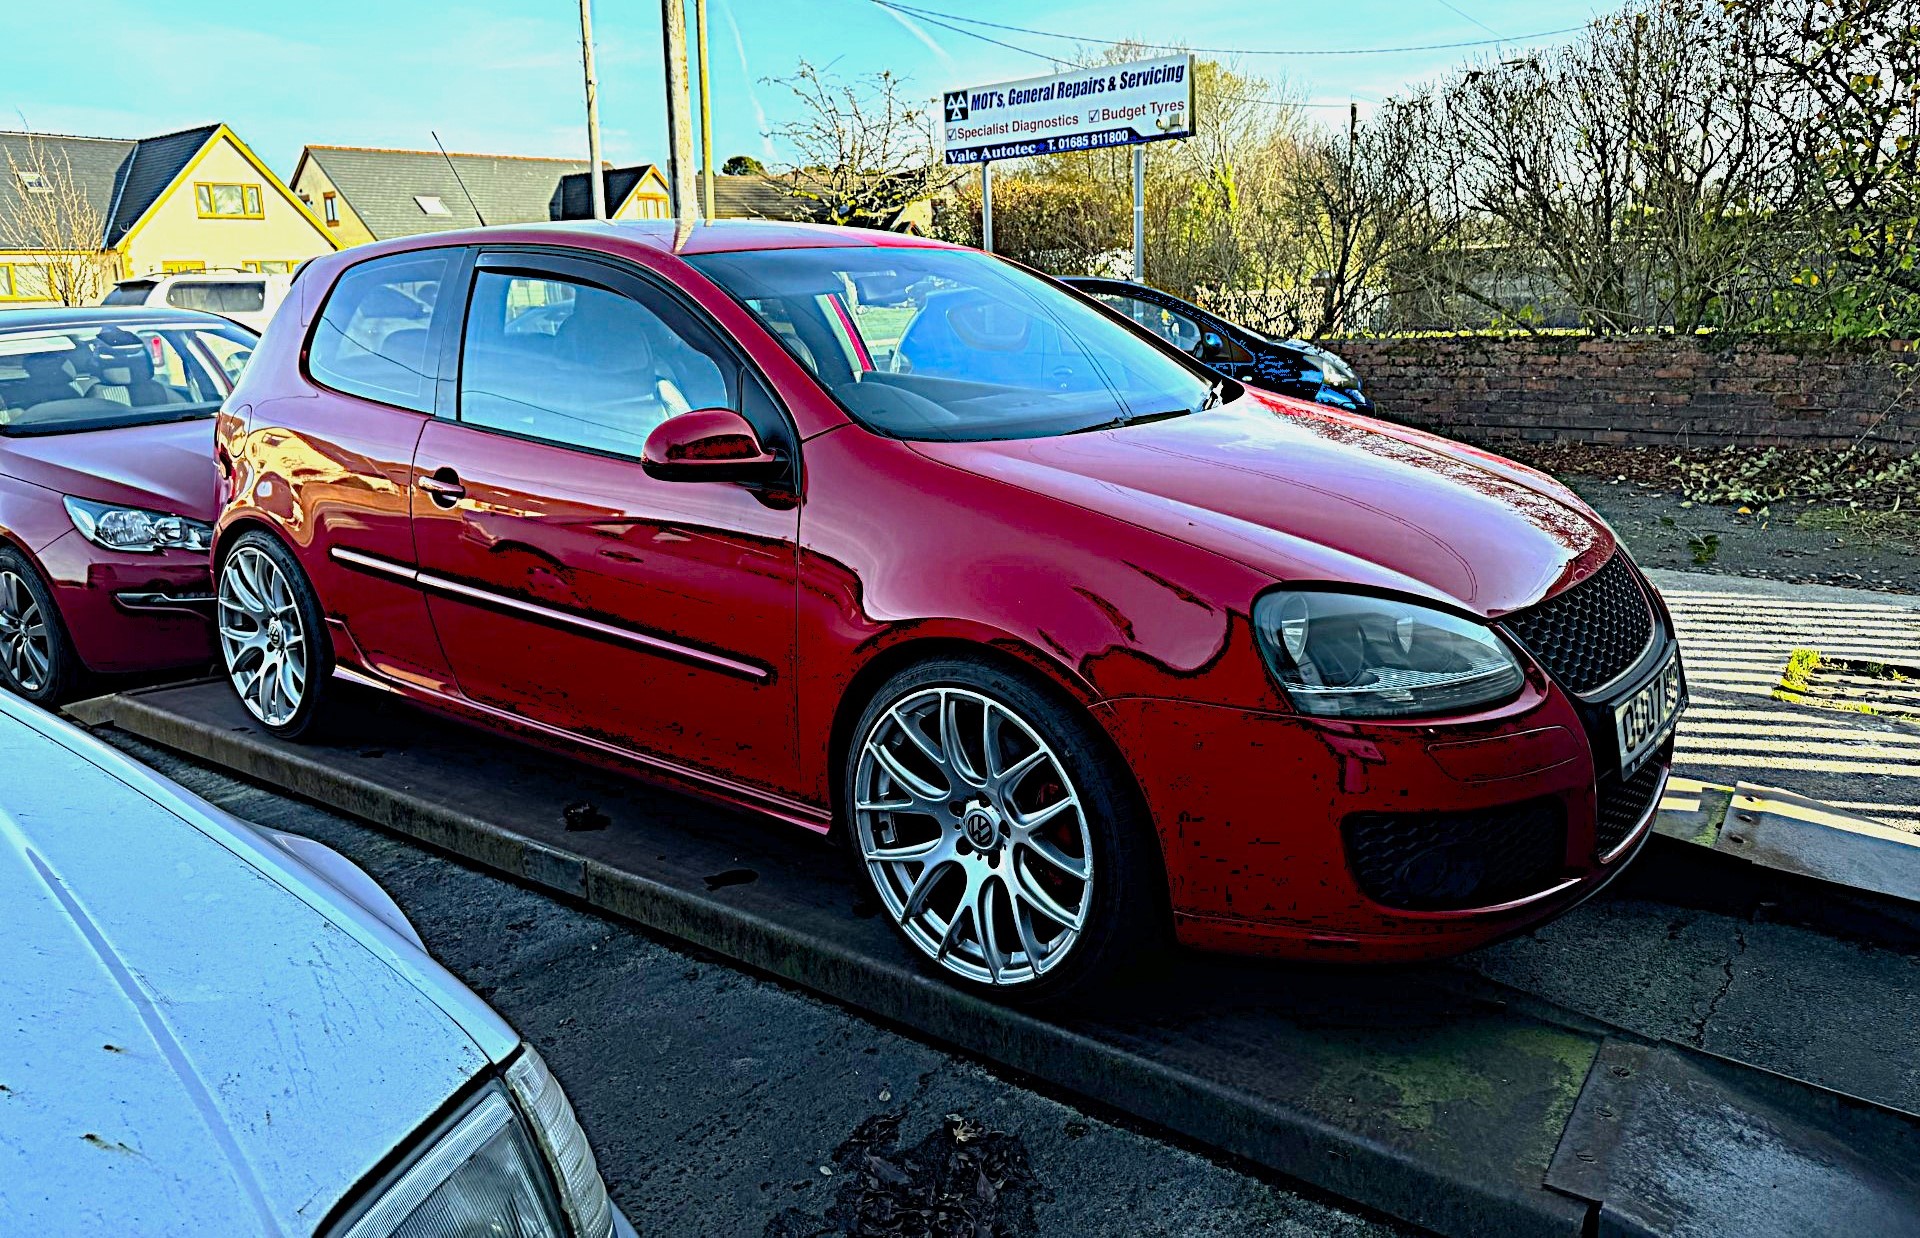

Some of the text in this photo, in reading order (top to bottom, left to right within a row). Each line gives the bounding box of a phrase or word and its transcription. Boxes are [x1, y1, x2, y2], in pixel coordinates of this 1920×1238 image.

[970, 64, 1185, 111] MOT's, General Repairs & Servicing
[1102, 101, 1185, 121] Budget Tyres
[957, 114, 1079, 141] Specialist Diagnostics
[1058, 135, 1089, 149] 01685
[1091, 130, 1129, 145] 811800
[947, 143, 1037, 163] Vale Autotec
